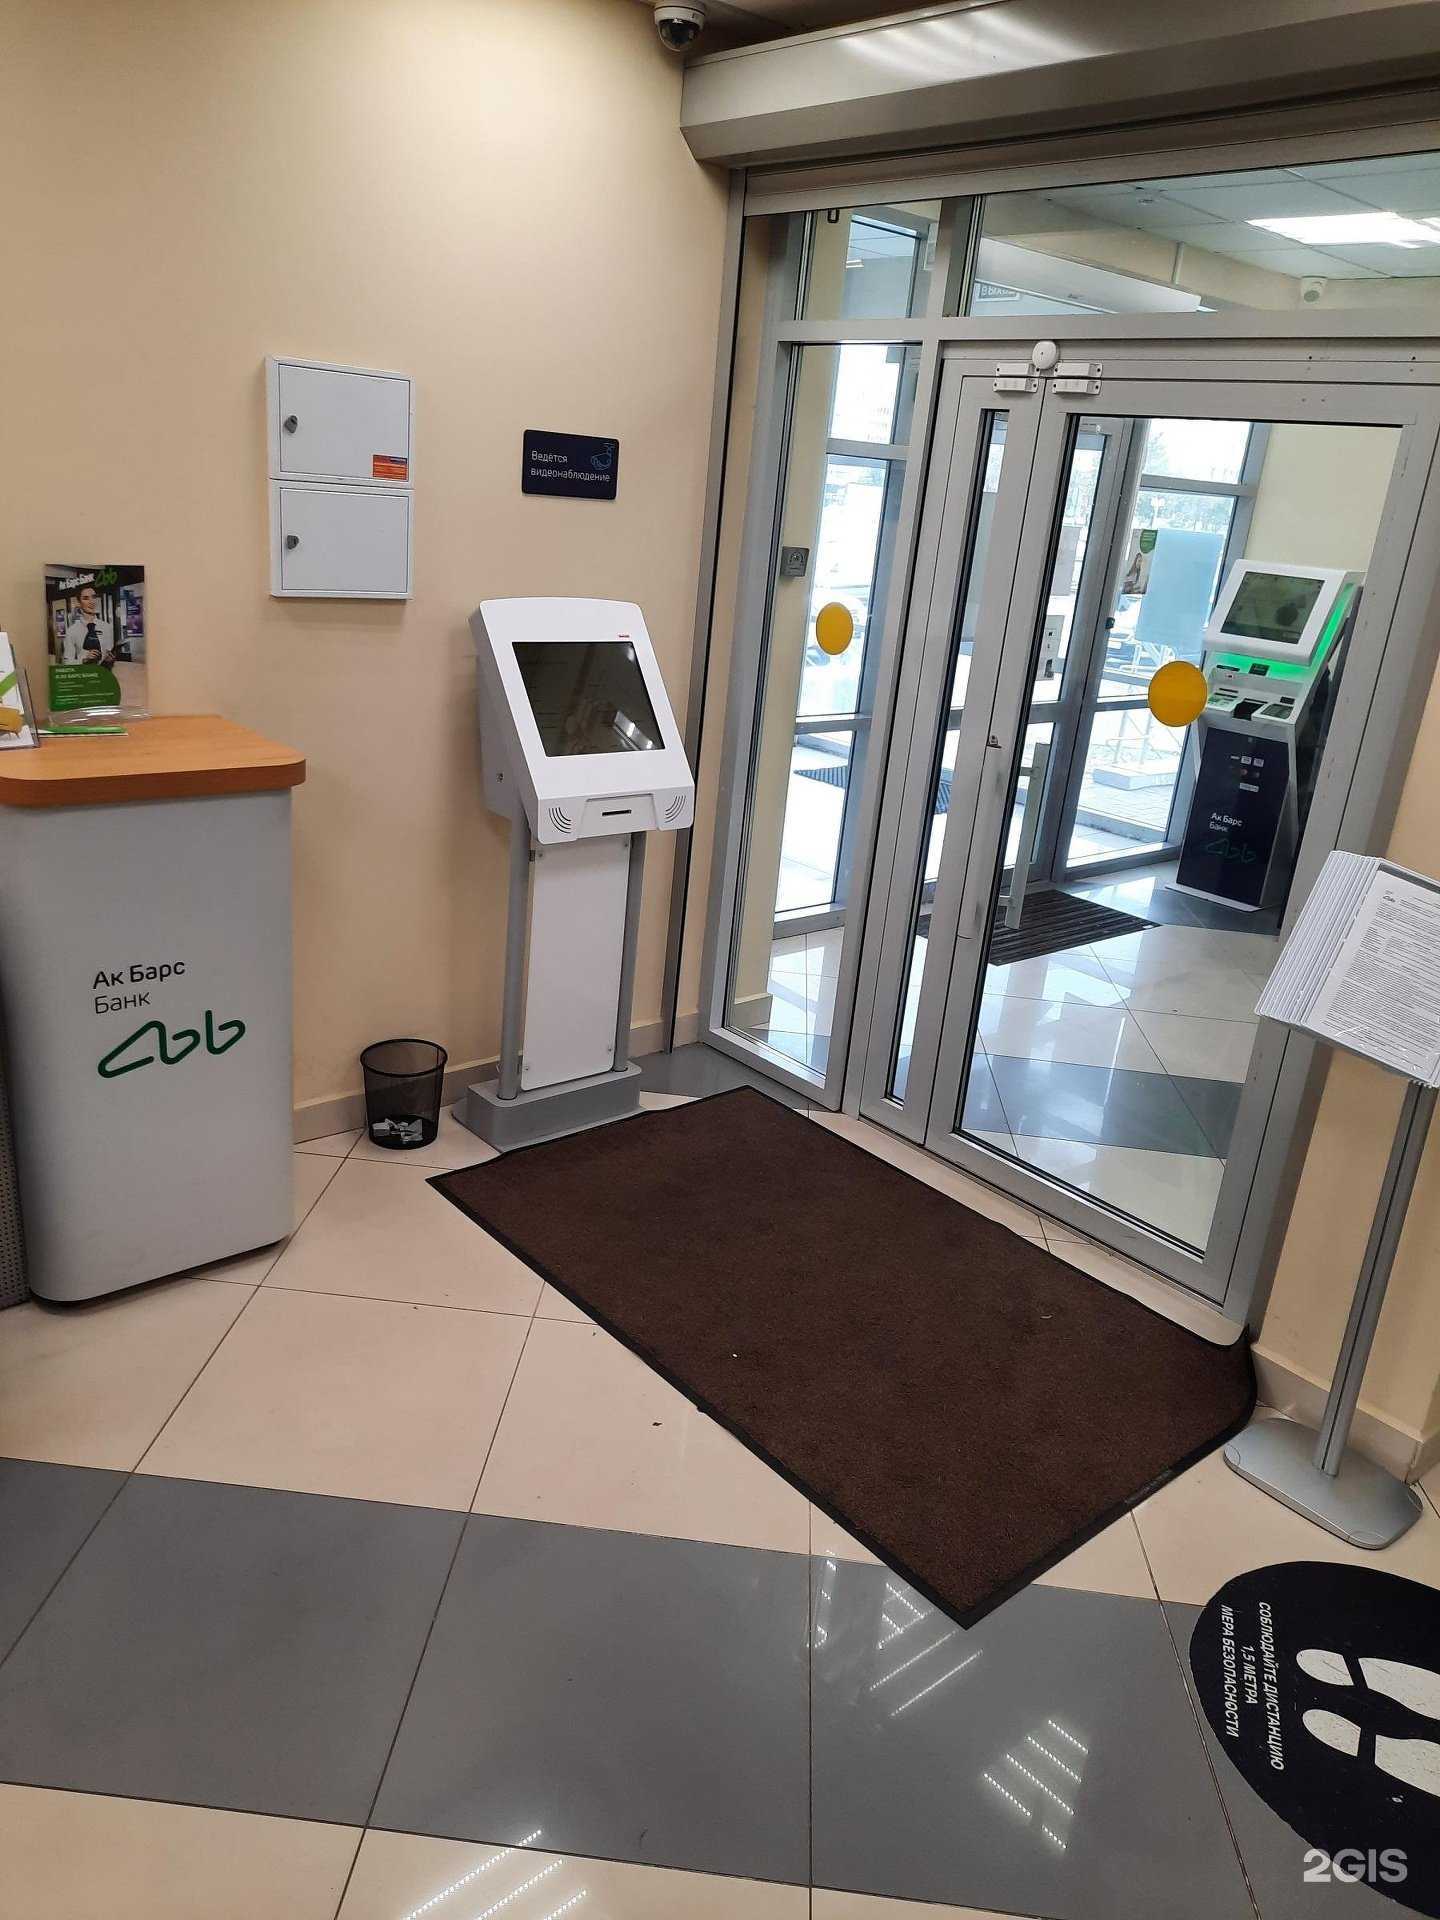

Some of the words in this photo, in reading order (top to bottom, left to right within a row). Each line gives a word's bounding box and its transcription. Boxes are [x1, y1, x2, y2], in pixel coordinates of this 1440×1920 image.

[530, 467, 611, 482] видеонаблюдение
[1210, 812, 1222, 821] Ак
[1223, 815, 1243, 827] Барс
[93, 970, 124, 989] Ак
[129, 961, 186, 982] Барс
[94, 991, 151, 1014] Банк
[1221, 1604, 1235, 1636] МЕРА
[1240, 1645, 1256, 1662] 1,5
[1259, 1601, 1279, 1683] СОБЛЮДАЙТЕ
[1222, 1637, 1239, 1737] БЕЗОПАСНОСТИ
[1243, 1662, 1258, 1704] МЕТРА
[1262, 1682, 1285, 1770] ДИСТАНЦИЮ
